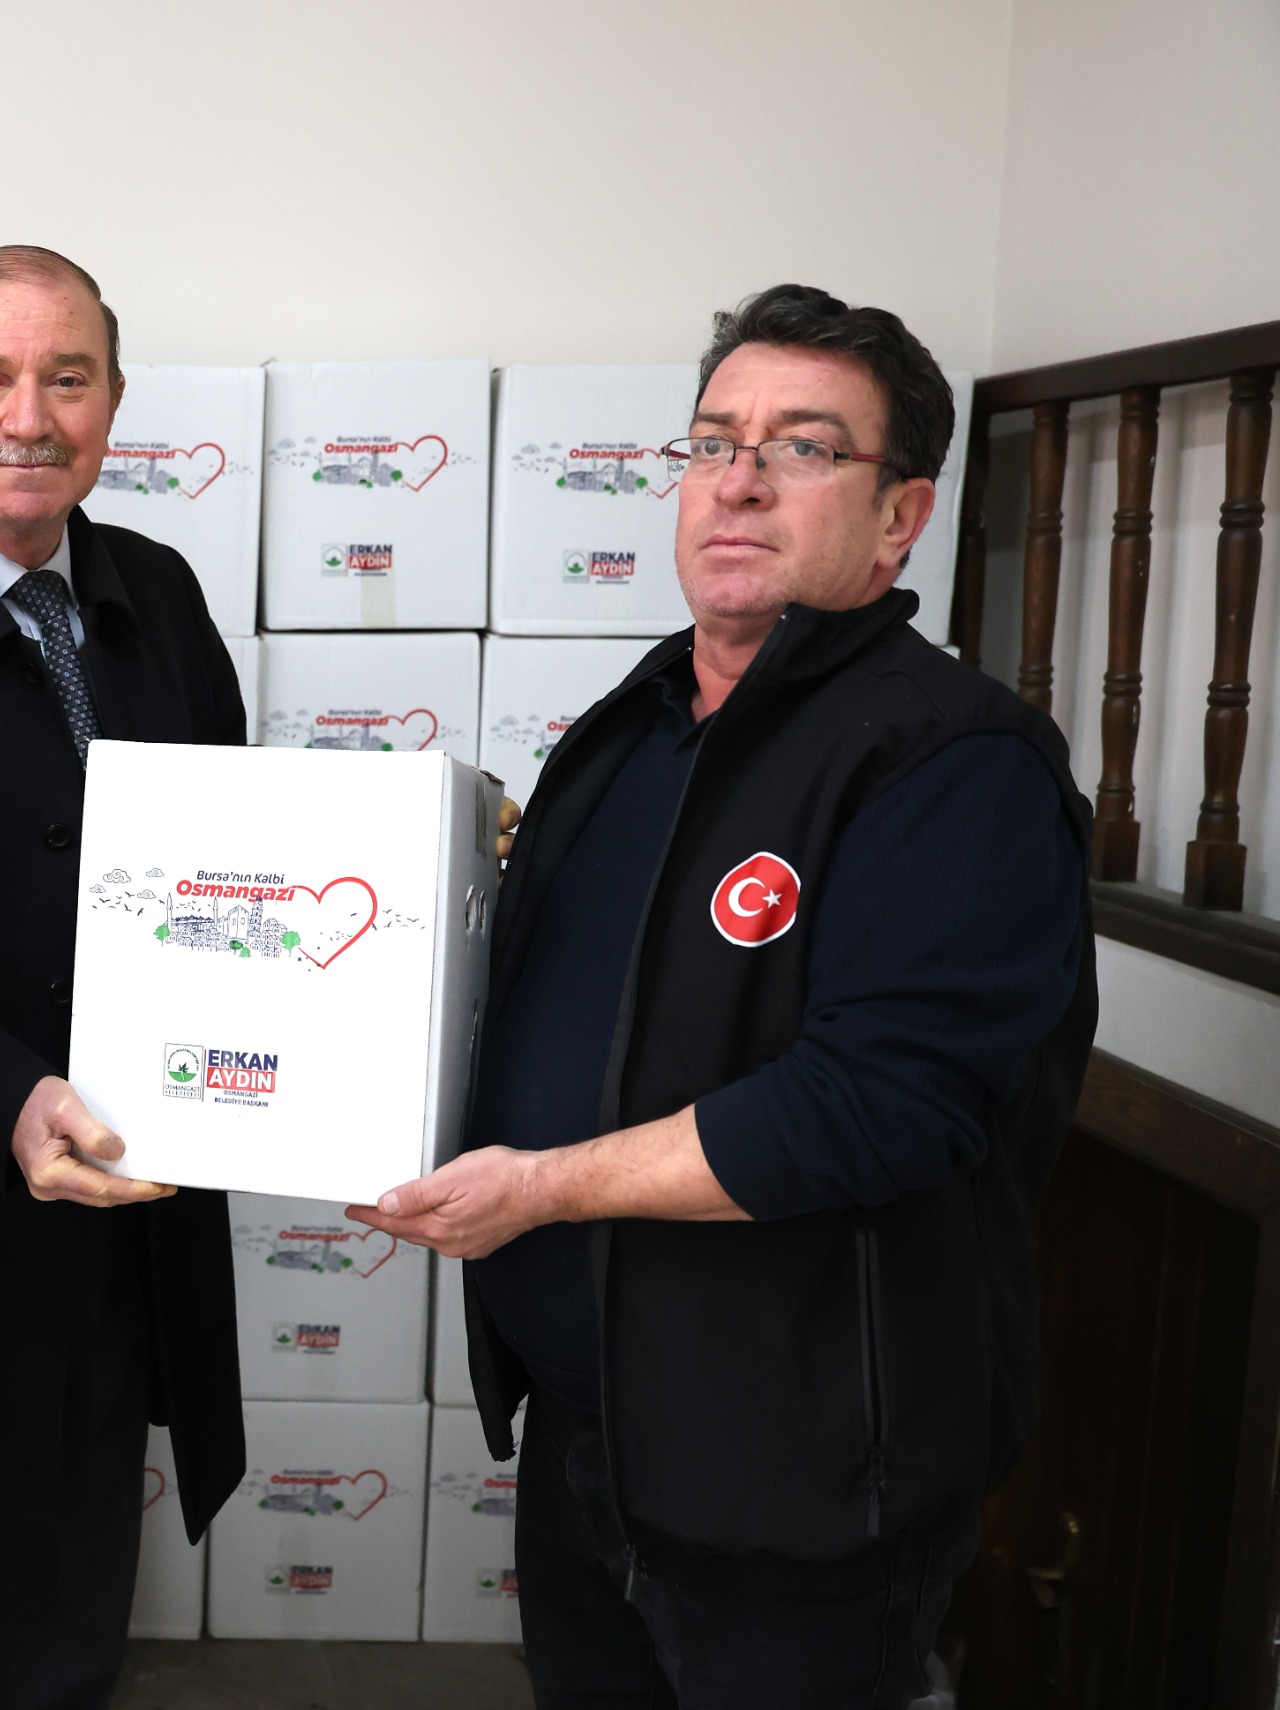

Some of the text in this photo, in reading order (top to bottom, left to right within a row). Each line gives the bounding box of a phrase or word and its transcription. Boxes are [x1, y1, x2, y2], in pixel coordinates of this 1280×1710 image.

[350, 544, 392, 554] ERKAN
[592, 552, 636, 562] ERKAN
[196, 870, 285, 885] Bursa'nın Kalbi
[176, 879, 296, 903] Osmangazi
[207, 1049, 278, 1072] ERKAN
[207, 1068, 273, 1091] AYDIN
